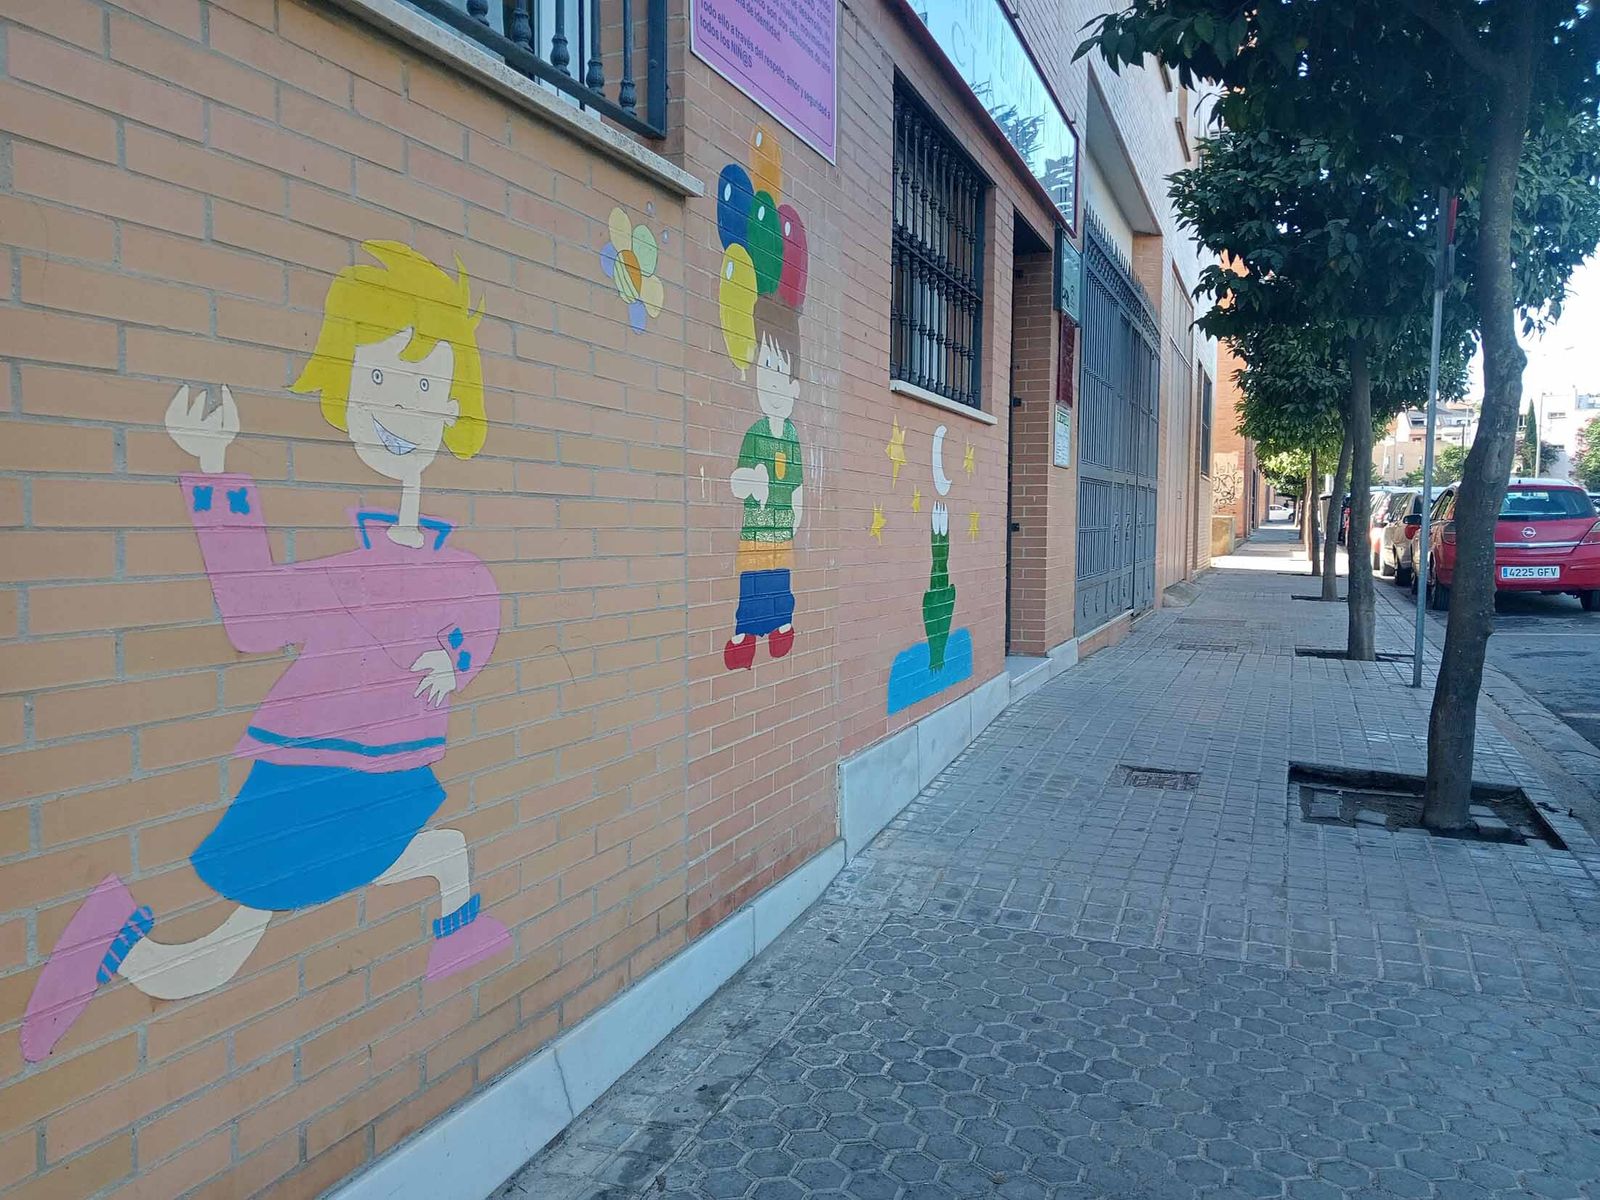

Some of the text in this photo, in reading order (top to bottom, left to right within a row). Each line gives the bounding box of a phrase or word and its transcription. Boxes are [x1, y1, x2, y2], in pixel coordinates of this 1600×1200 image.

[700, 14, 752, 68] todos los NIÑ@S
[718, 12, 729, 30] ello
[736, 27, 754, 52] través
[755, 44, 763, 60] del
[787, 75, 800, 90] amor
[1509, 568, 1557, 576] 4225 GFV
